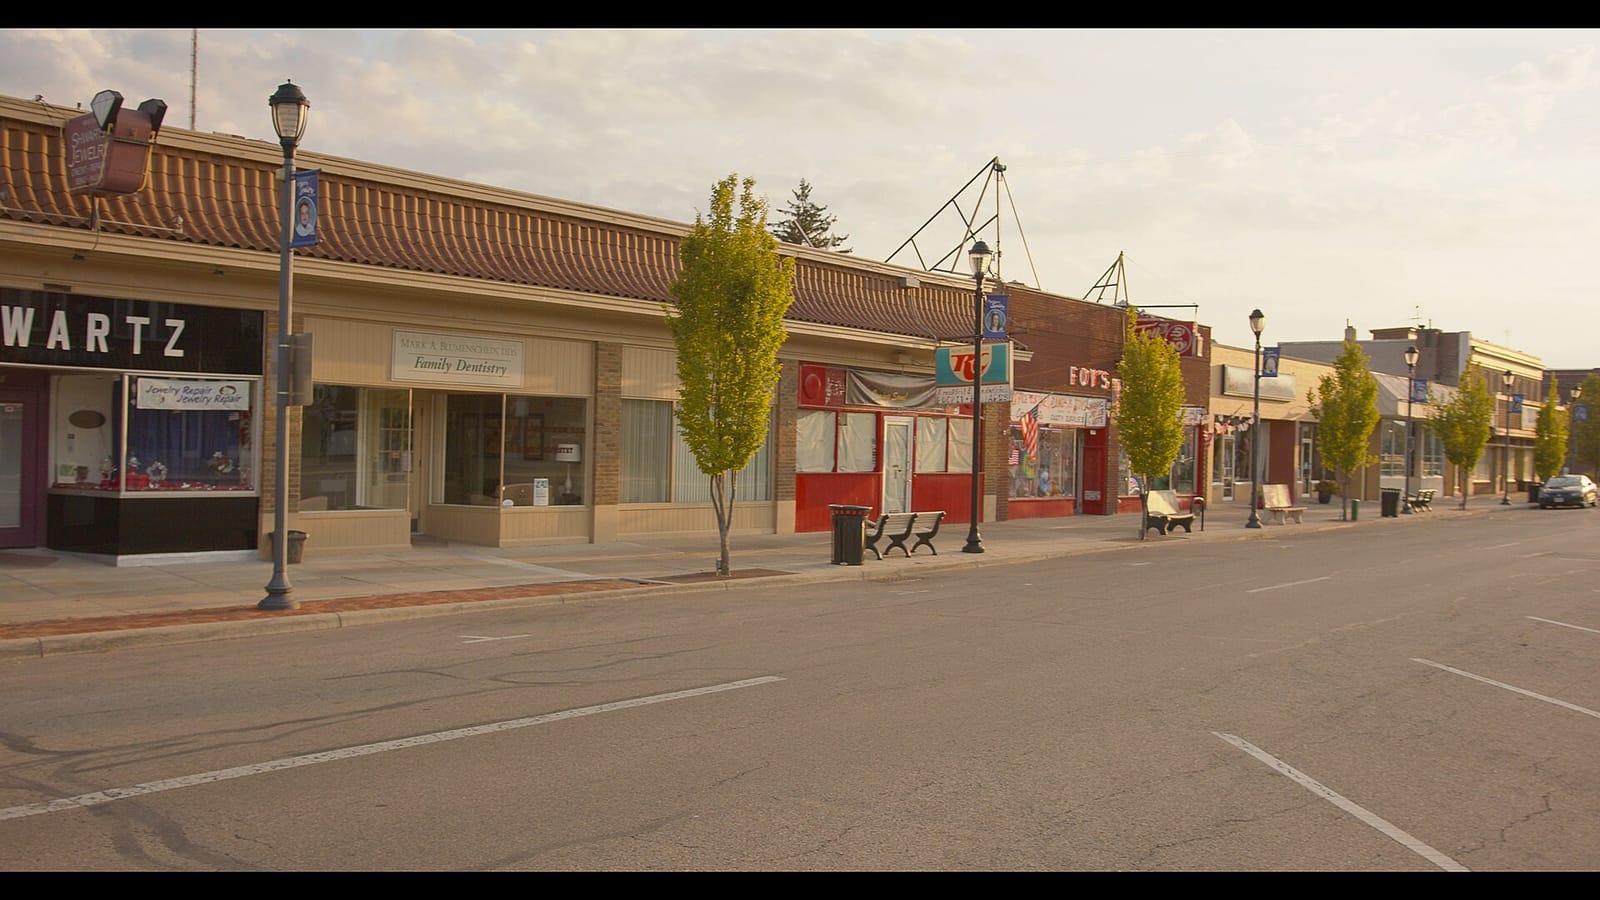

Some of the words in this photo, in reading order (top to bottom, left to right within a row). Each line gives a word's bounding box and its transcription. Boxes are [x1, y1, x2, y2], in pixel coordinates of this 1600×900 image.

[68, 143, 104, 168] JEWELR
[1, 305, 186, 358] WARTZ
[414, 356, 452, 374] Family
[456, 359, 508, 377] Dentistry
[951, 352, 990, 381] RC
[145, 385, 181, 396] Jewelry
[183, 386, 214, 396] Repair
[177, 395, 212, 405] Jewelry
[215, 394, 243, 404] Repair
